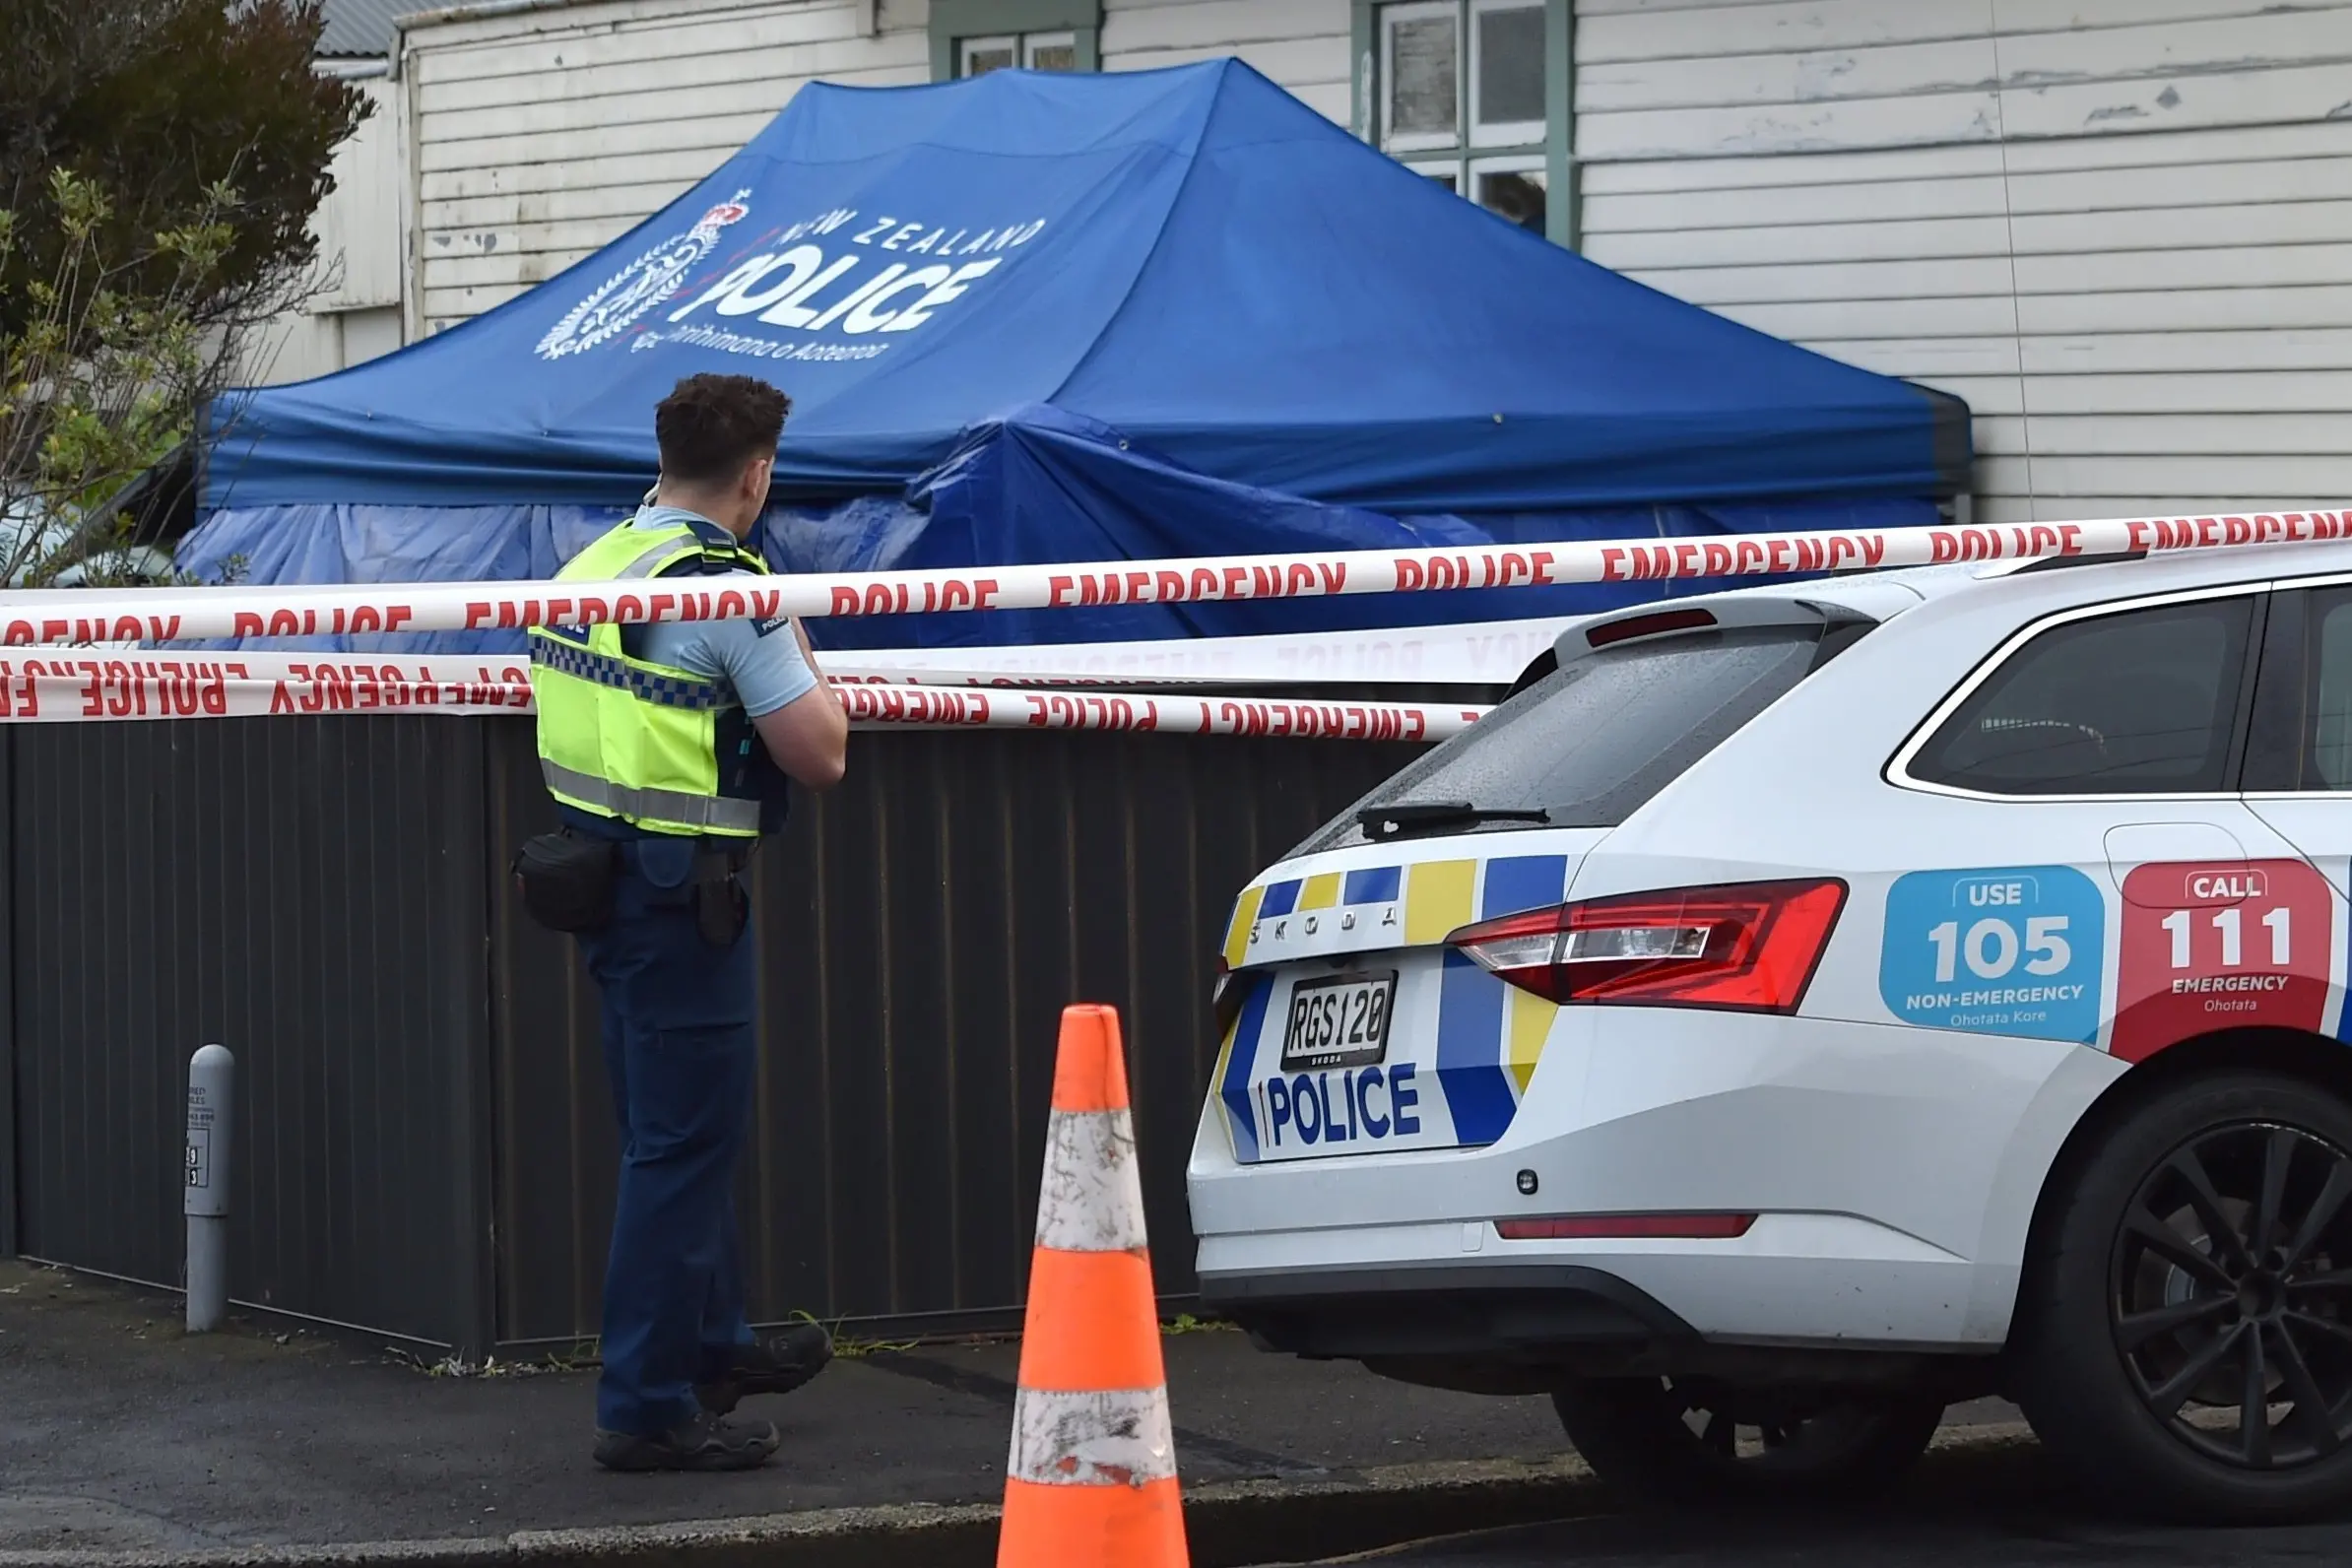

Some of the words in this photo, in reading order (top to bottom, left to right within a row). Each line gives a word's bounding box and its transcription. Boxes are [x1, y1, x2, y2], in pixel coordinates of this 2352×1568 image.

[852, 217, 1046, 255] ZEALAND
[667, 245, 1003, 334] POLICE
[787, 341, 889, 361] Aotearoa
[81, 675, 228, 717] POLICE
[1970, 882, 2022, 906] USE
[2192, 877, 2261, 898] CALL
[1927, 915, 2071, 983] 105
[2161, 907, 2290, 968] 111
[1906, 984, 2085, 1010] NON-EMERGENCY
[2172, 976, 2289, 994] EMERGENCY
[1289, 988, 1386, 1051] RGS120
[1950, 1013, 2009, 1027] Ohotata
[2013, 1011, 2047, 1023] Kore
[2204, 999, 2257, 1013] Ohotata
[1269, 1063, 1421, 1147] POLICE
